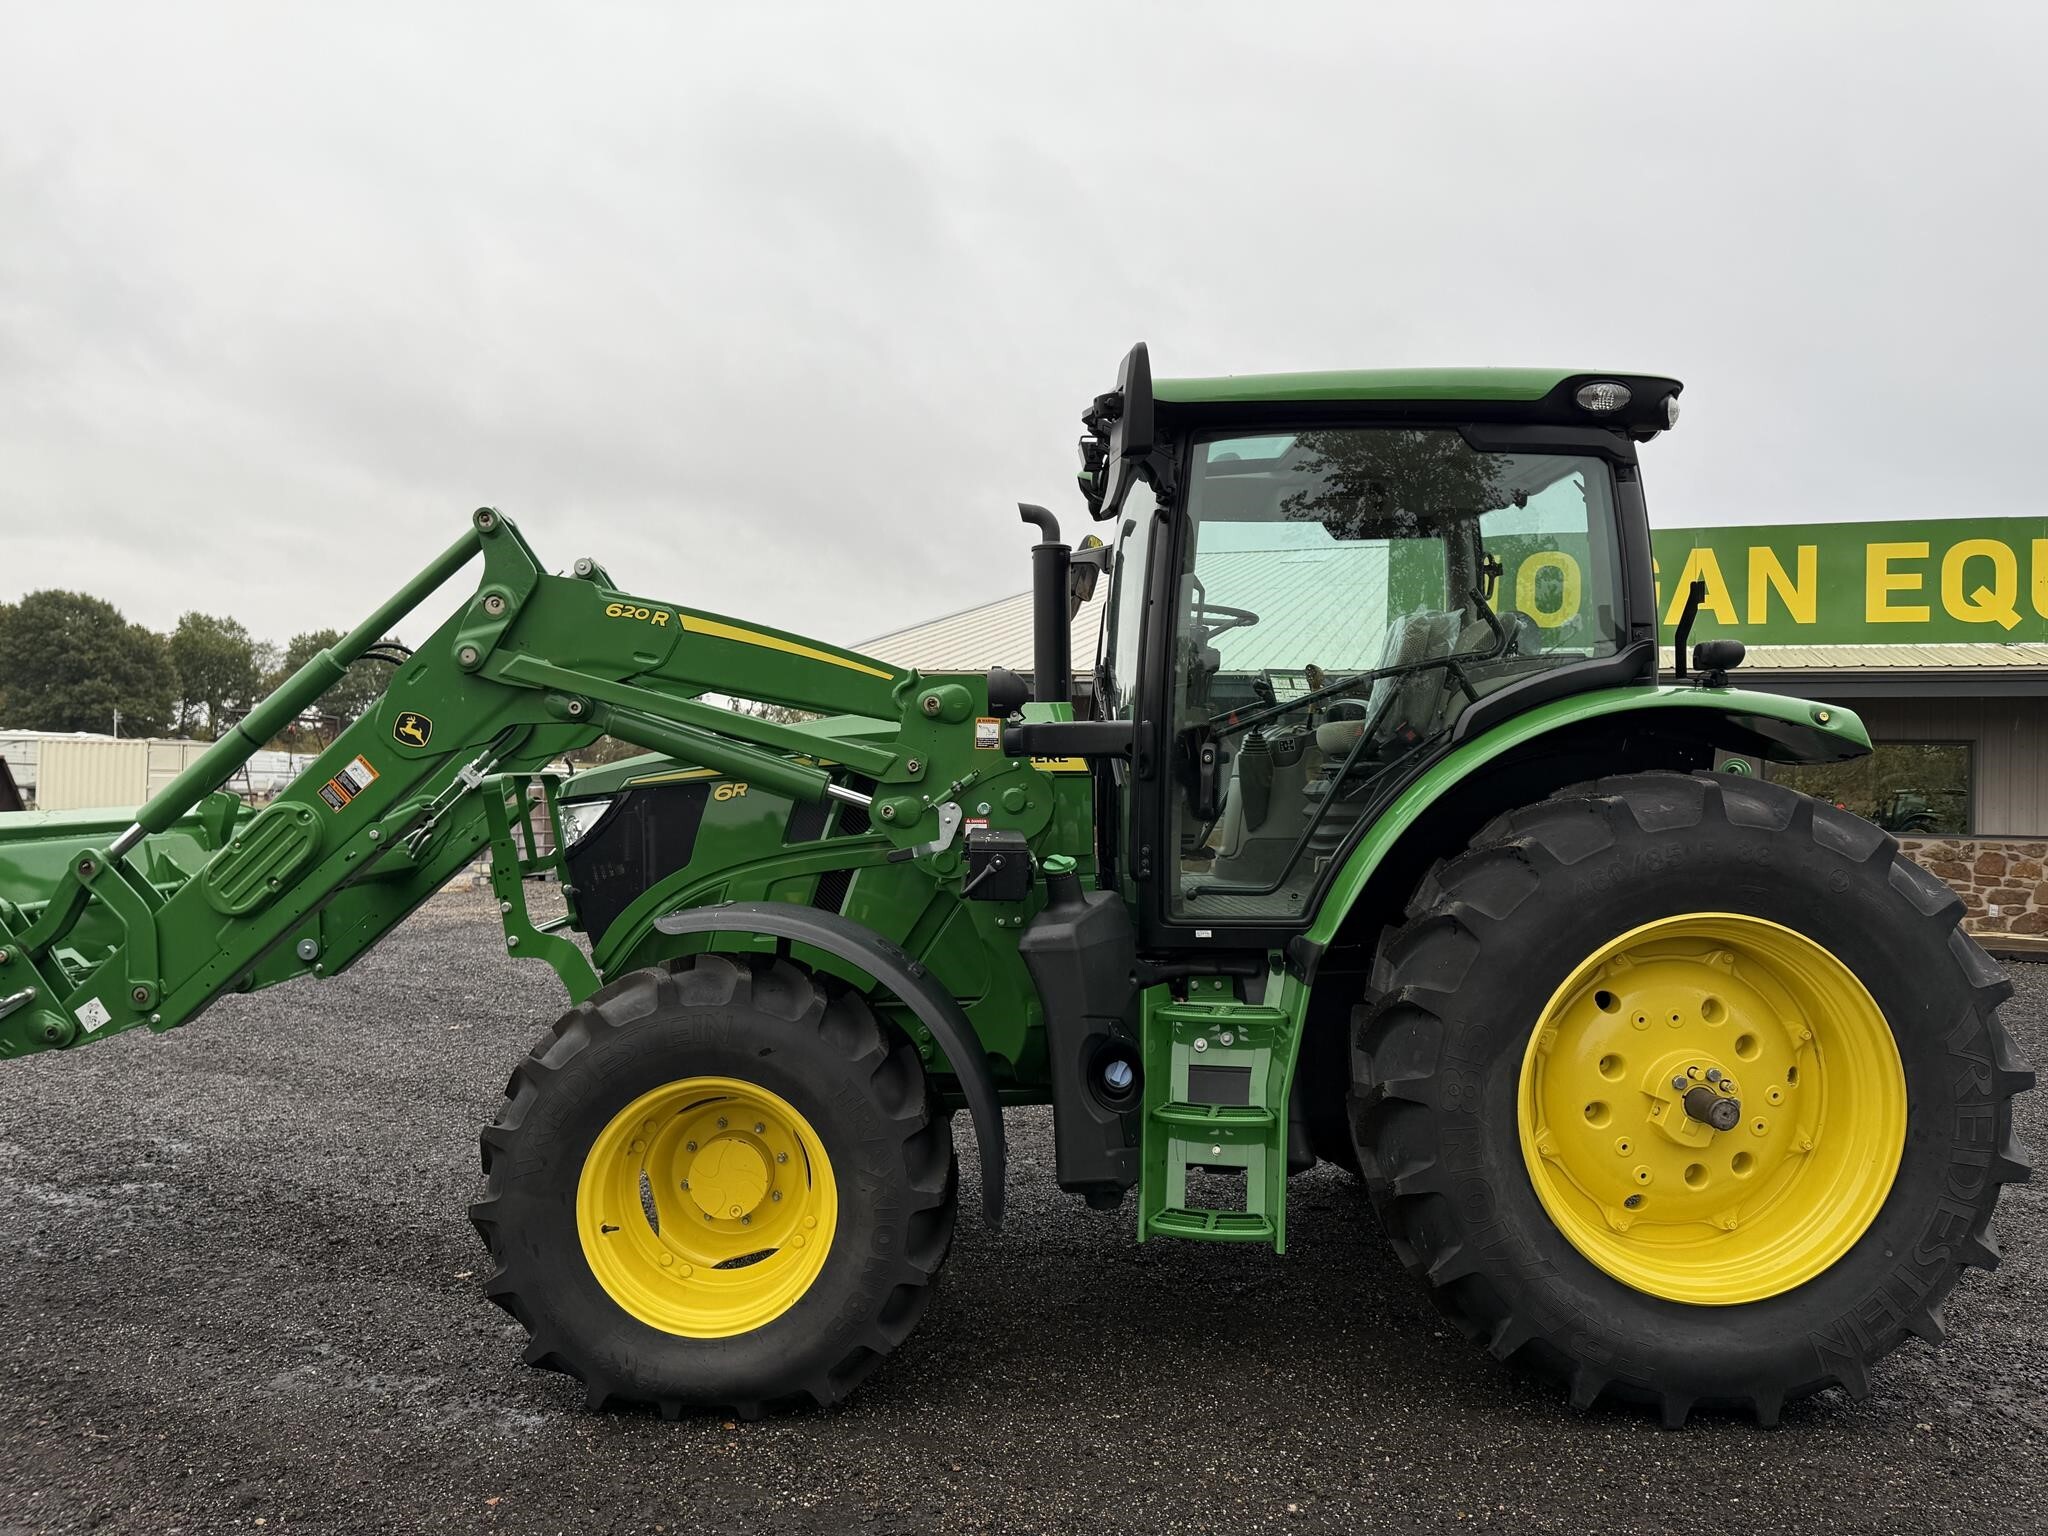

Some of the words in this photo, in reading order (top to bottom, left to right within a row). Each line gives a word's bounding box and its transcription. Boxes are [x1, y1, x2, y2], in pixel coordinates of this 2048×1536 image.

[1483, 546, 1817, 627] OAN
[1865, 538, 2048, 631] EQ
[605, 602, 670, 627] 620R
[714, 782, 749, 801] 6R
[1808, 1008, 1998, 1376] VREDESTEIN
